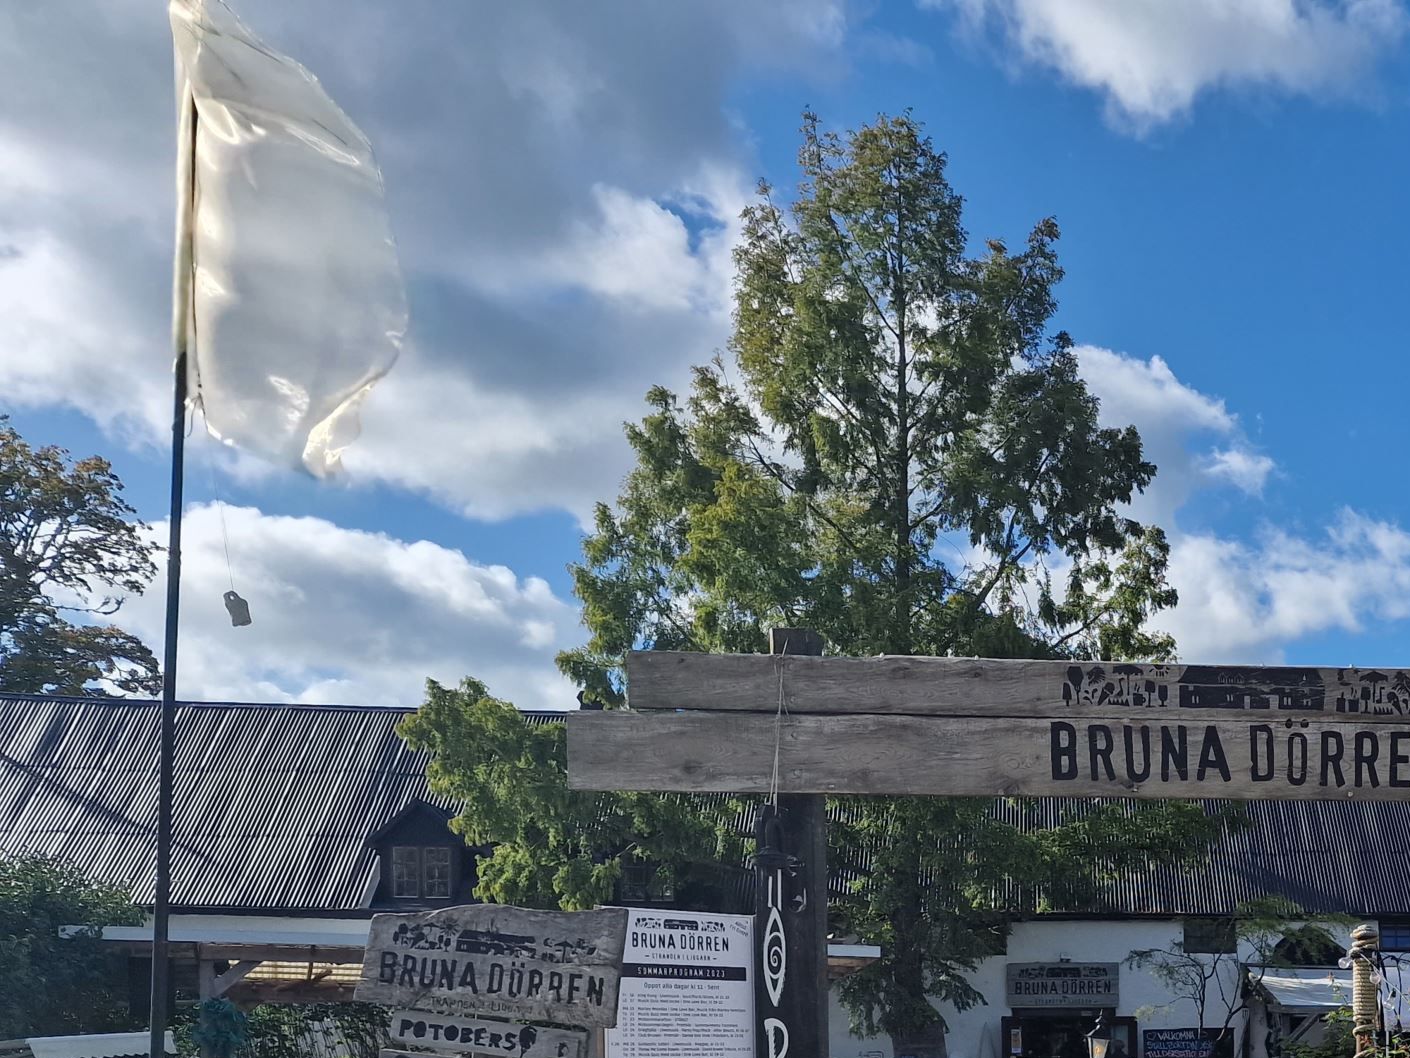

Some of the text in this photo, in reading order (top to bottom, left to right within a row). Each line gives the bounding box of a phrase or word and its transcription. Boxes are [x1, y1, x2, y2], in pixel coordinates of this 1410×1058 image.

[1050, 721, 1231, 783] BRUNA
[632, 932, 729, 951] BRUNA DÖRREN
[379, 951, 605, 1006] BRUNA DÖRREN
[637, 966, 725, 978] SOMMARPROGRAM 2023
[1015, 979, 1111, 995] BRUNA DÖRREN
[400, 1018, 517, 1051] POTOBERS
